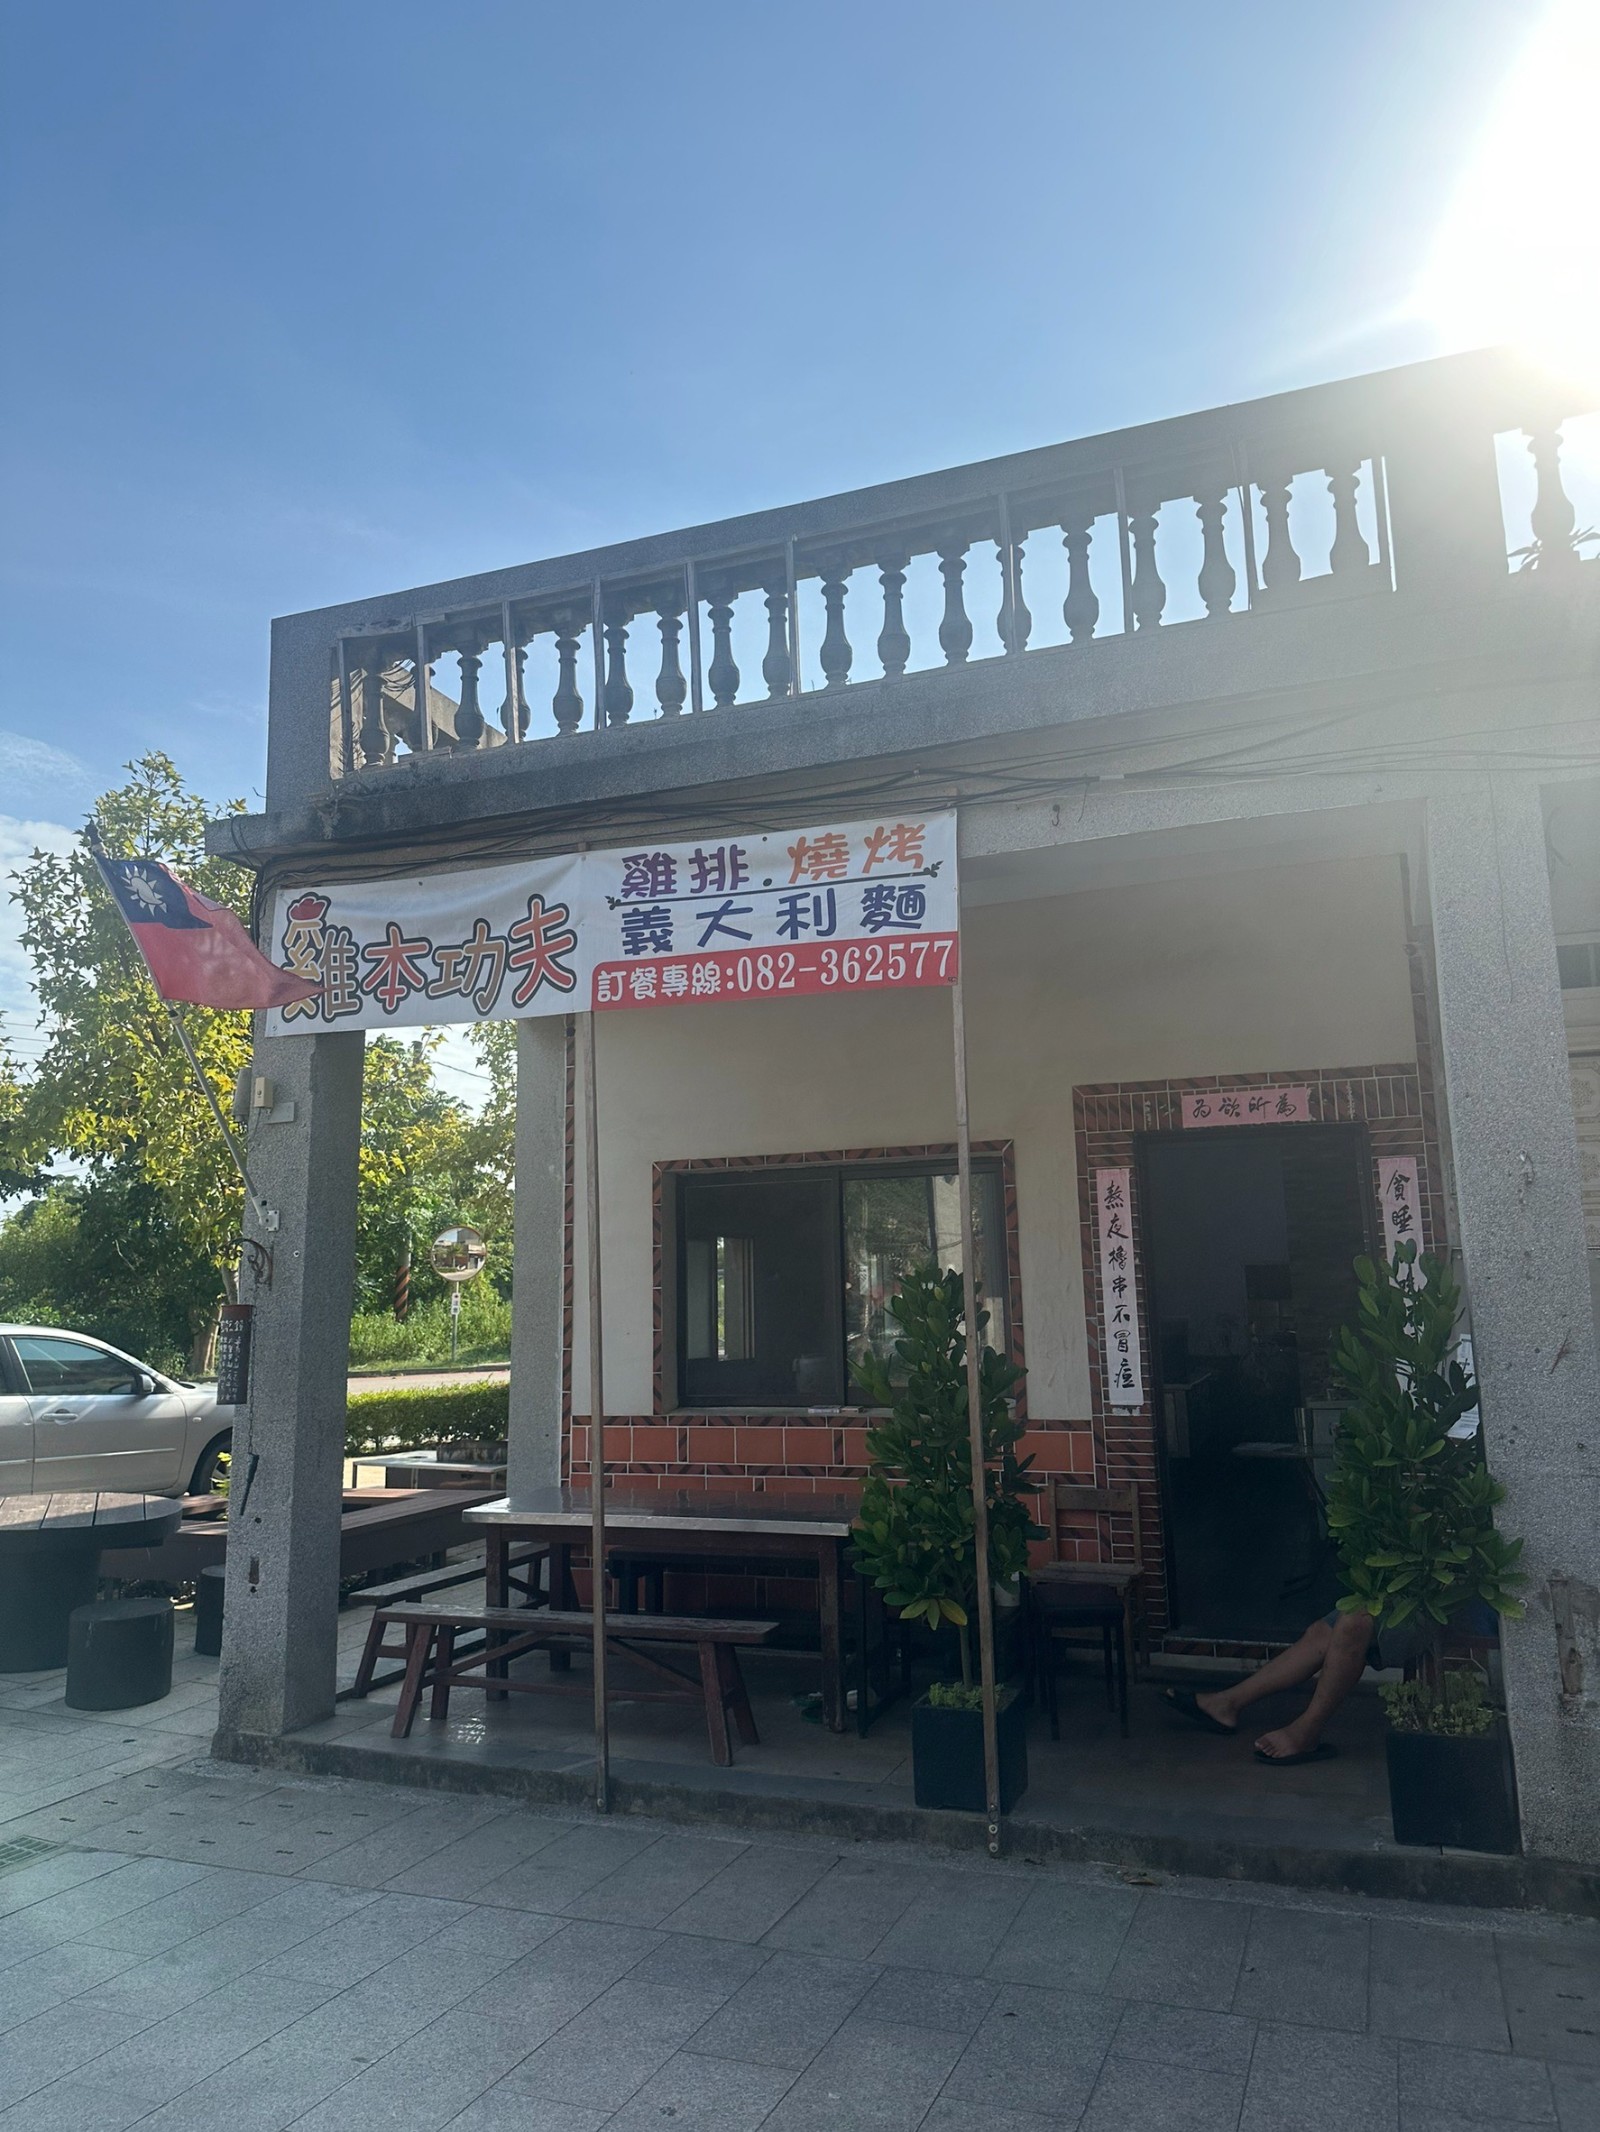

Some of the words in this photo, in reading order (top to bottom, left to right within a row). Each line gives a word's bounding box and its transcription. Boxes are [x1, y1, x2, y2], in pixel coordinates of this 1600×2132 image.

[281, 892, 577, 1023] 雞本功夫
[621, 884, 926, 956] 義大利麵
